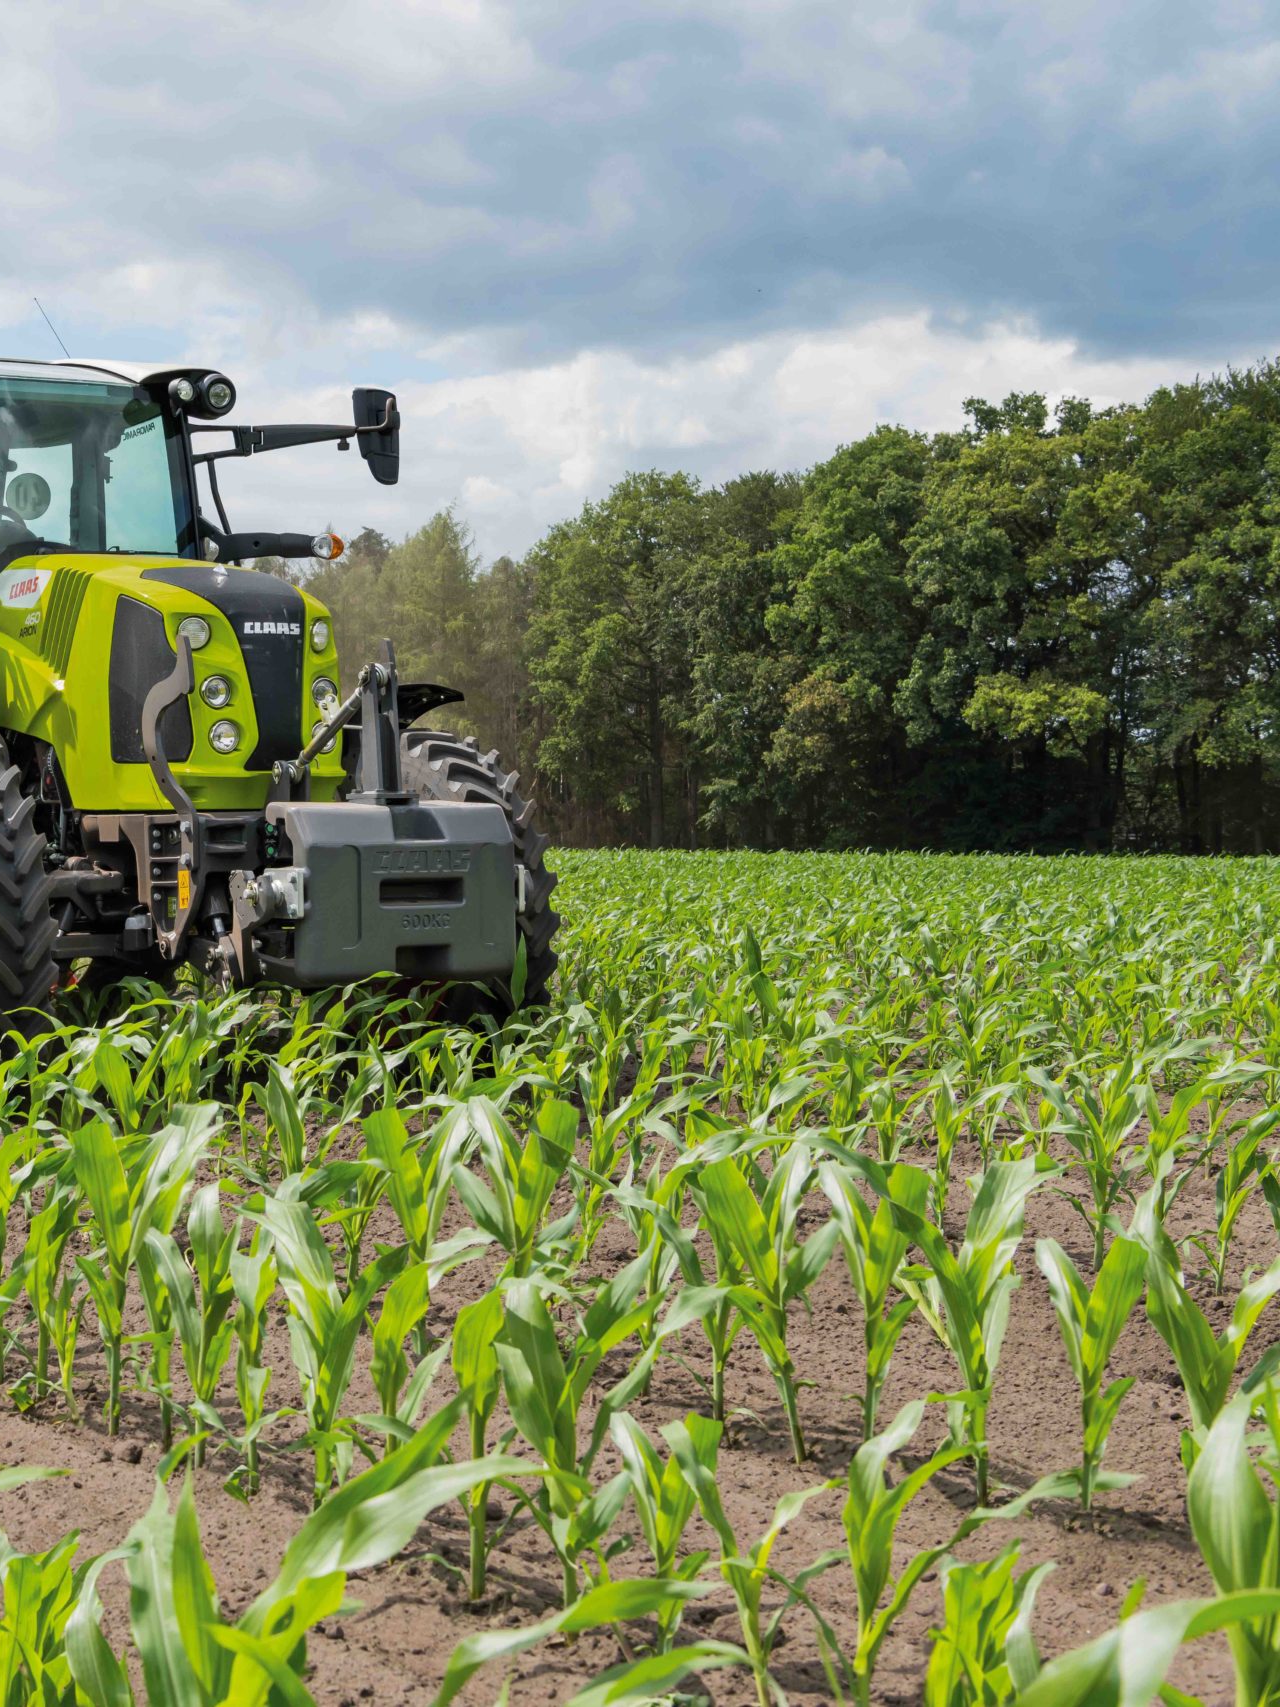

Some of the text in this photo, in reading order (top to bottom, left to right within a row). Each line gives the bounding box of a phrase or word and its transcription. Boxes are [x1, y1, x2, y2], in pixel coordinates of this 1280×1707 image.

[9, 576, 40, 600] CLAAS
[25, 611, 41, 625] 460
[18, 624, 37, 639] ARION
[243, 621, 300, 635] CLAAS
[371, 849, 471, 874] CLAAS
[401, 912, 451, 930] 600KG
